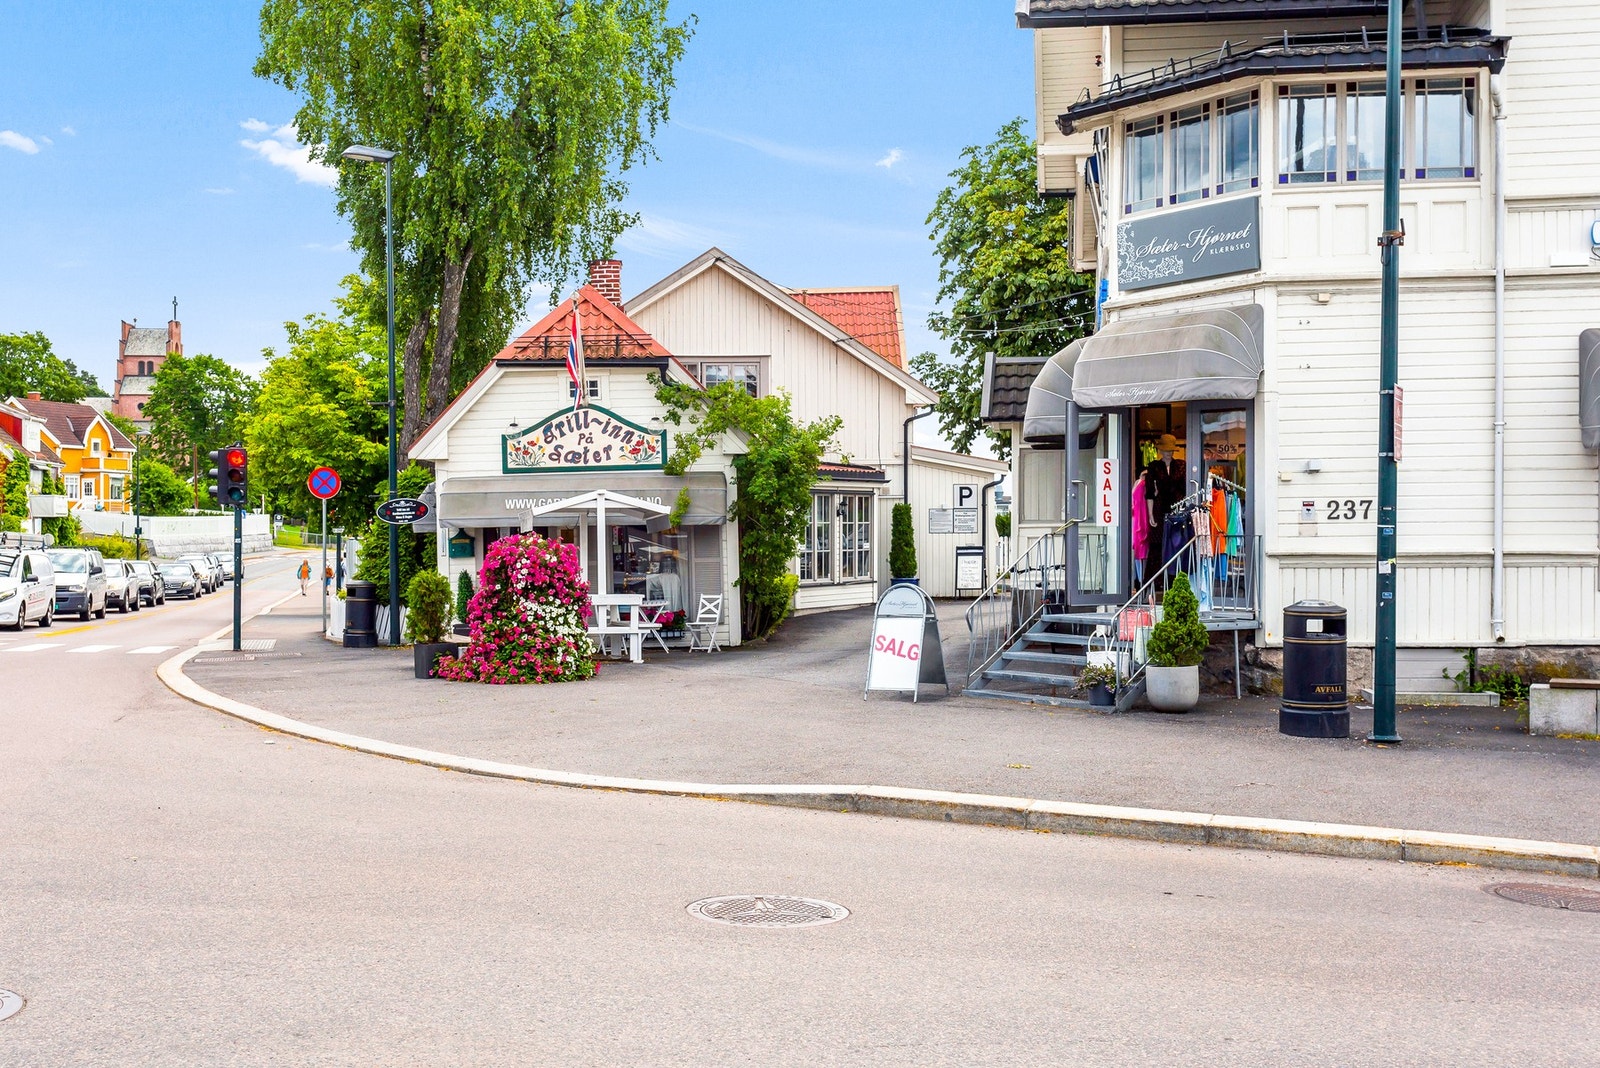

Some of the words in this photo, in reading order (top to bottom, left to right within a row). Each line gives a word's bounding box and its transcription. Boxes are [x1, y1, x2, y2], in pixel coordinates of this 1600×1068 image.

[1218, 444, 1237, 453] 50%
[959, 486, 973, 506] P
[1102, 461, 1113, 524] SALG
[1326, 500, 1373, 520] 237
[875, 634, 920, 661] SALG
